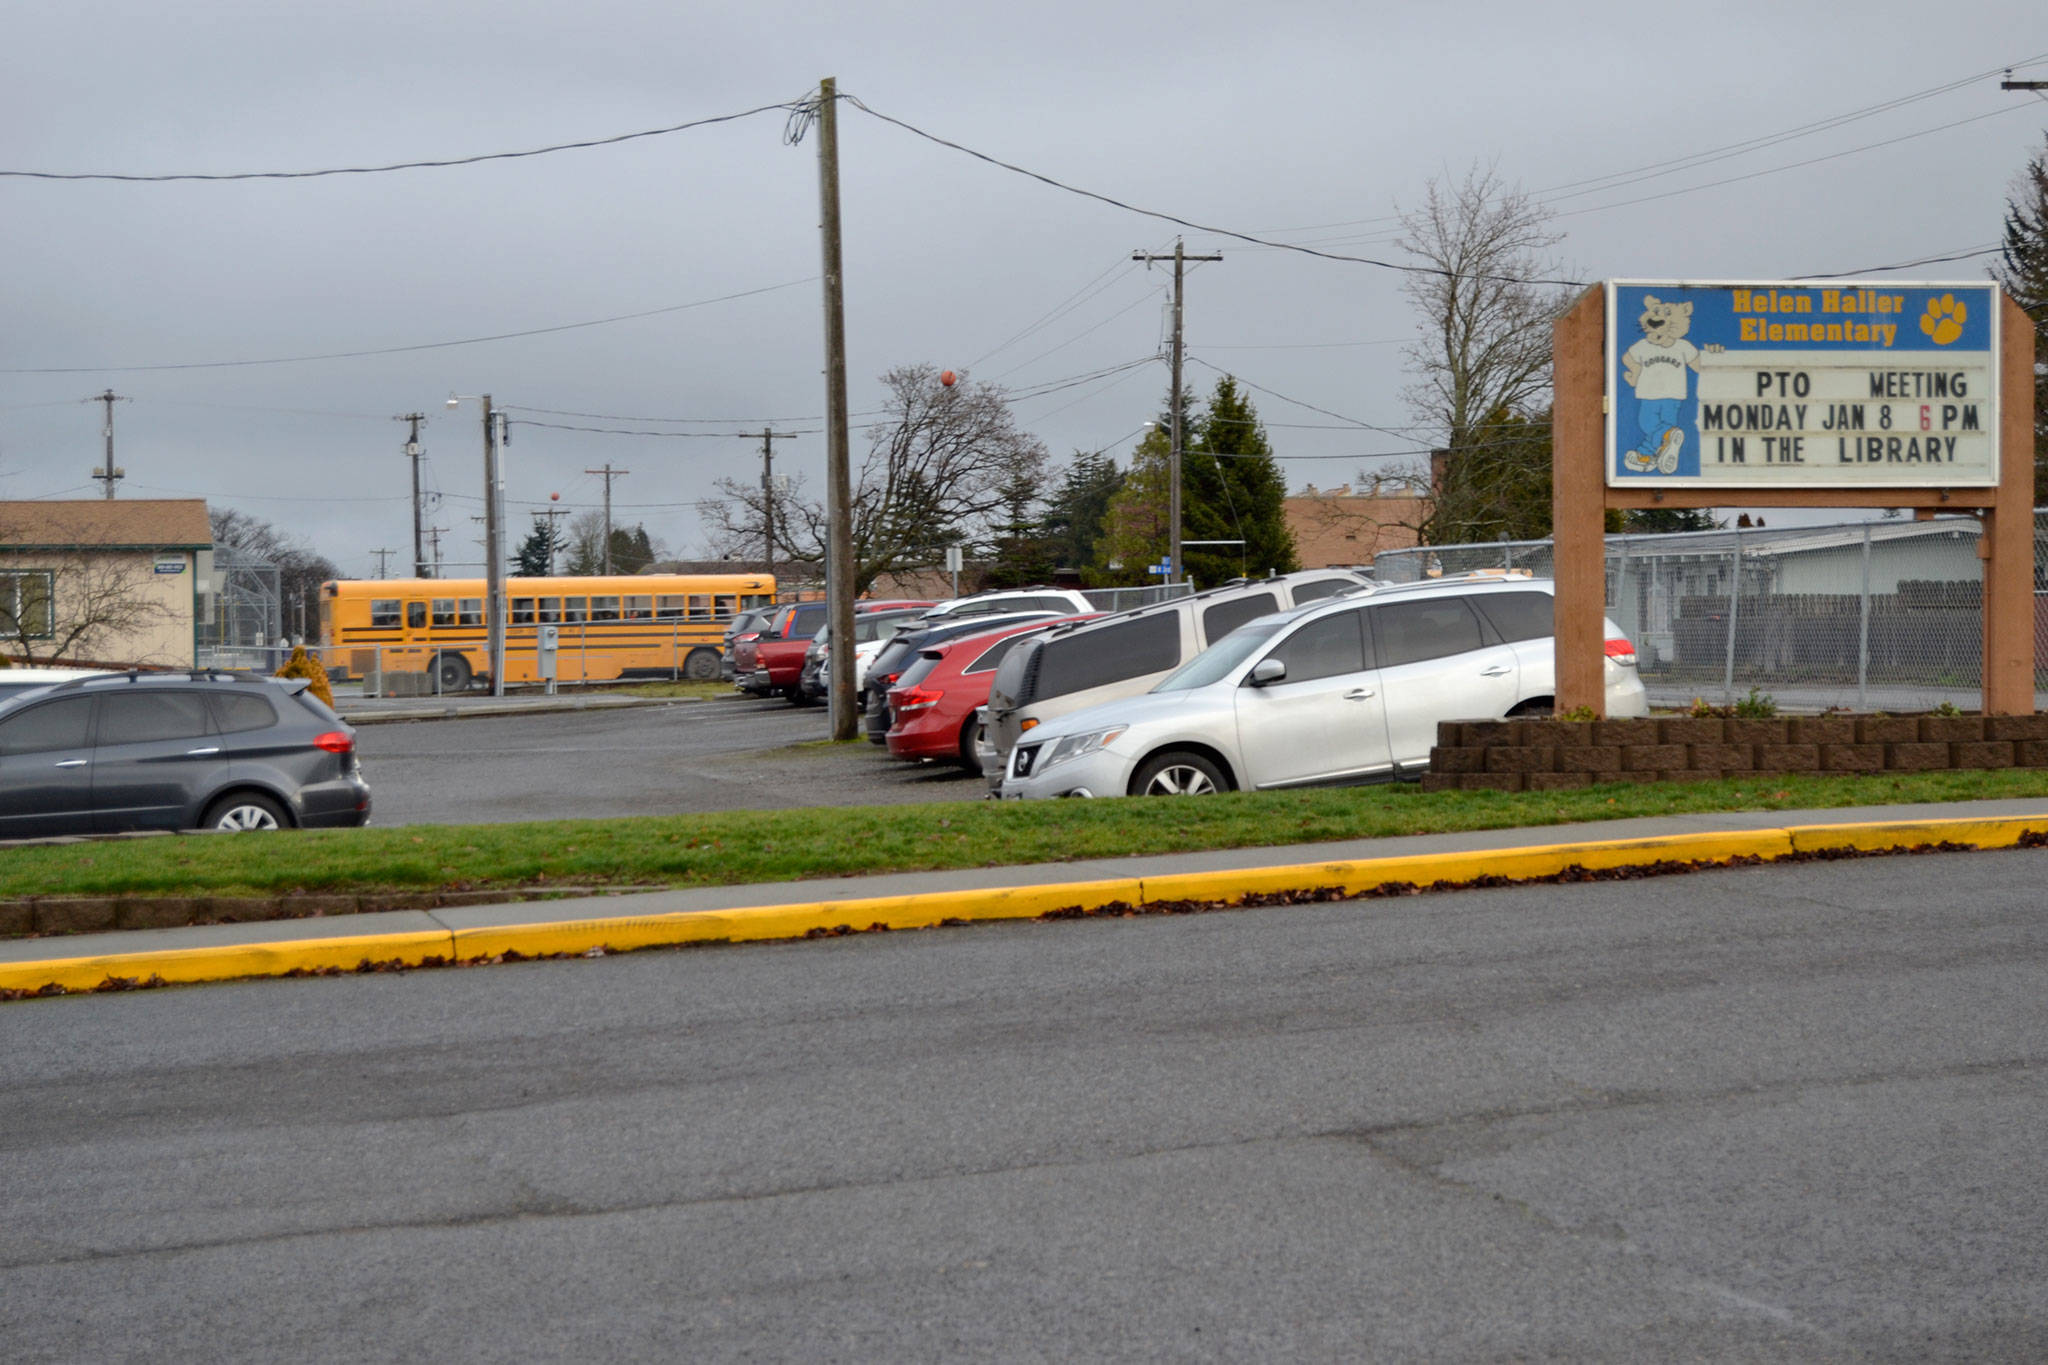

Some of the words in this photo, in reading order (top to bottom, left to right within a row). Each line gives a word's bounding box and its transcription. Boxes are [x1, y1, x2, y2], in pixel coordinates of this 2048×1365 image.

[1732, 290, 1812, 313] Helen
[1821, 290, 1905, 313] Haller
[1739, 318, 1898, 347] Elementary
[1644, 355, 1682, 368] COUGARS
[1756, 371, 1811, 398] PTO
[1869, 371, 1968, 398] MEETING
[1703, 404, 1808, 430] MONDAY
[1822, 404, 1865, 430] JAN
[1879, 404, 1893, 430] 8
[1920, 404, 1931, 431] 6
[1942, 404, 1980, 430] PM
[1717, 437, 1745, 463] IN
[1761, 437, 1805, 463] THE
[1839, 436, 1957, 463] LIBRARY
